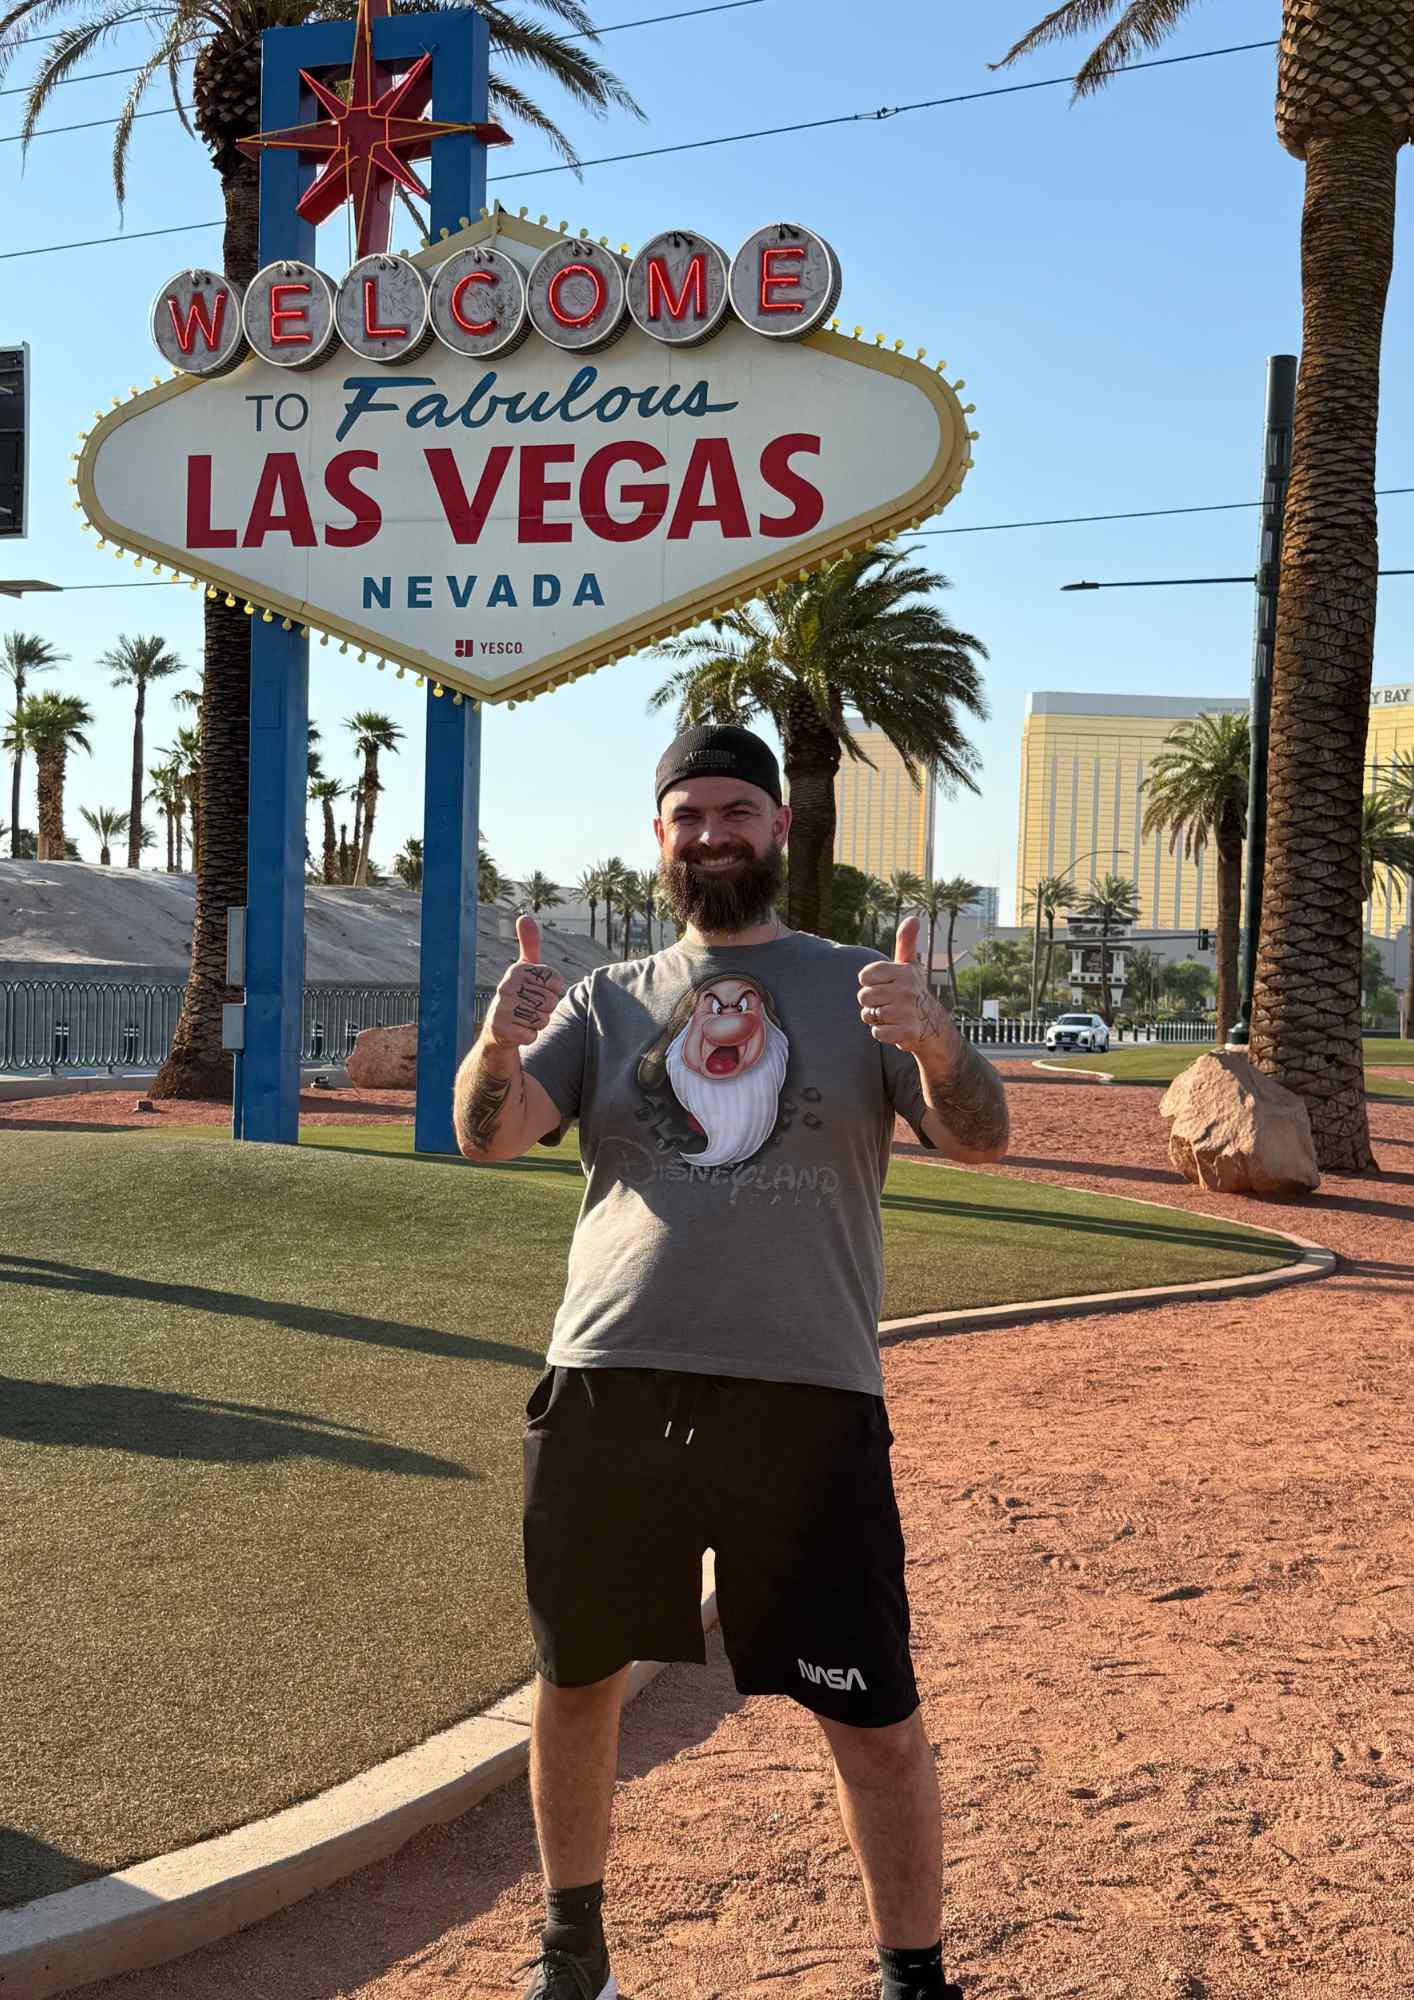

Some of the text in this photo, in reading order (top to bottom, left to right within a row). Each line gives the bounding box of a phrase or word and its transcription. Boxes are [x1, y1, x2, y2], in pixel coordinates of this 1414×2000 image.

[168, 244, 806, 355] WELCOME
[245, 366, 739, 442] TO Fabulous
[186, 433, 824, 548] LAS VEGAS
[362, 573, 605, 608] NEVADA
[480, 641, 523, 655] YESCO
[1384, 688, 1410, 703] BAY
[797, 1658, 868, 1691] NASA
